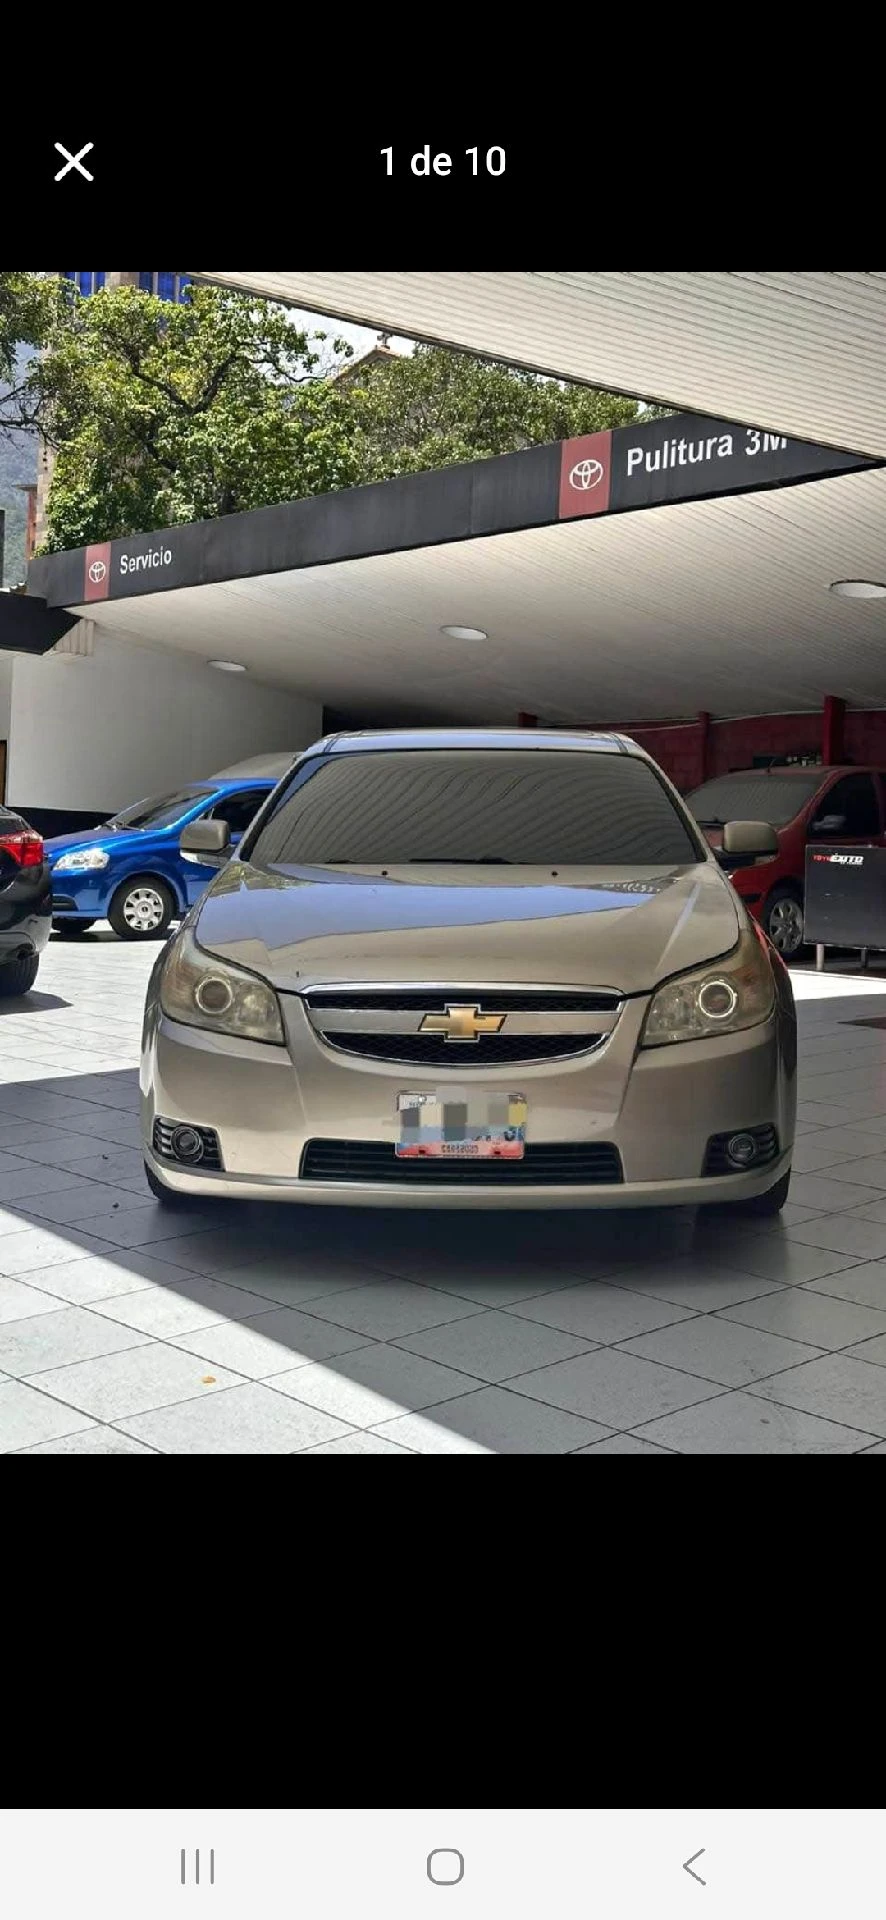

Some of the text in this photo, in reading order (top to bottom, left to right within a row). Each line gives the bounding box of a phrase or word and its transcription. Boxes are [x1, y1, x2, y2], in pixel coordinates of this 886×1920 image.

[626, 429, 788, 477] Pulitura 3M
[119, 545, 172, 575] Servicio
